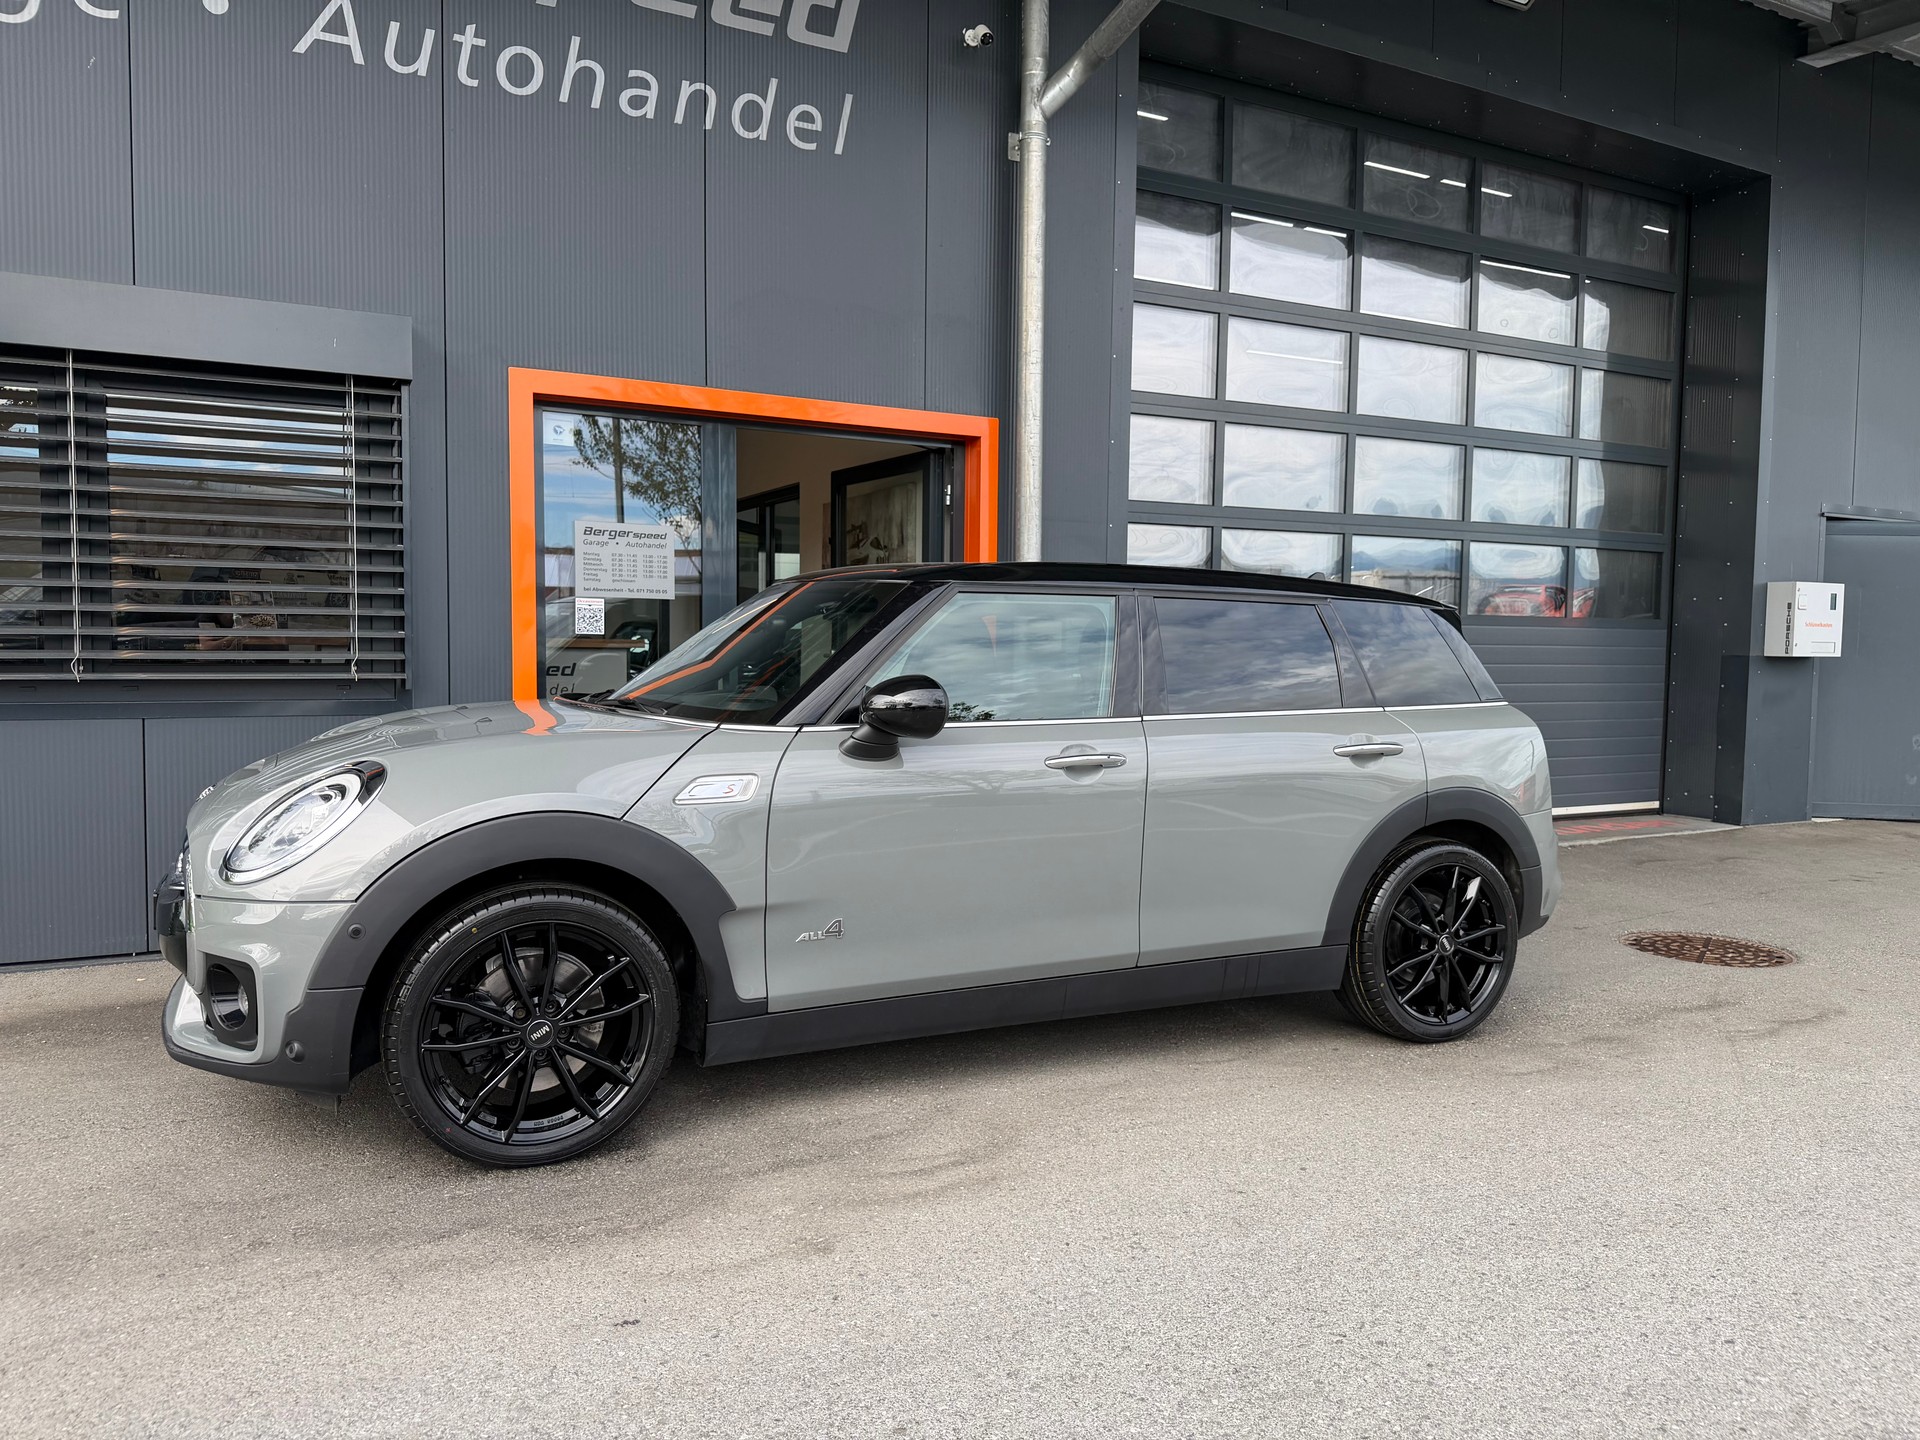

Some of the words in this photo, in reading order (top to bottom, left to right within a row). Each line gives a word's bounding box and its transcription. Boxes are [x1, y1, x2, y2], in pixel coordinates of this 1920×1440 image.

[292, 0, 854, 155] Autohandel
[583, 526, 668, 540] Bergerspeed
[583, 538, 610, 547] Garage
[625, 541, 668, 549] Autohandel
[796, 918, 844, 942] ALL4
[530, 1024, 550, 1041] MINI
